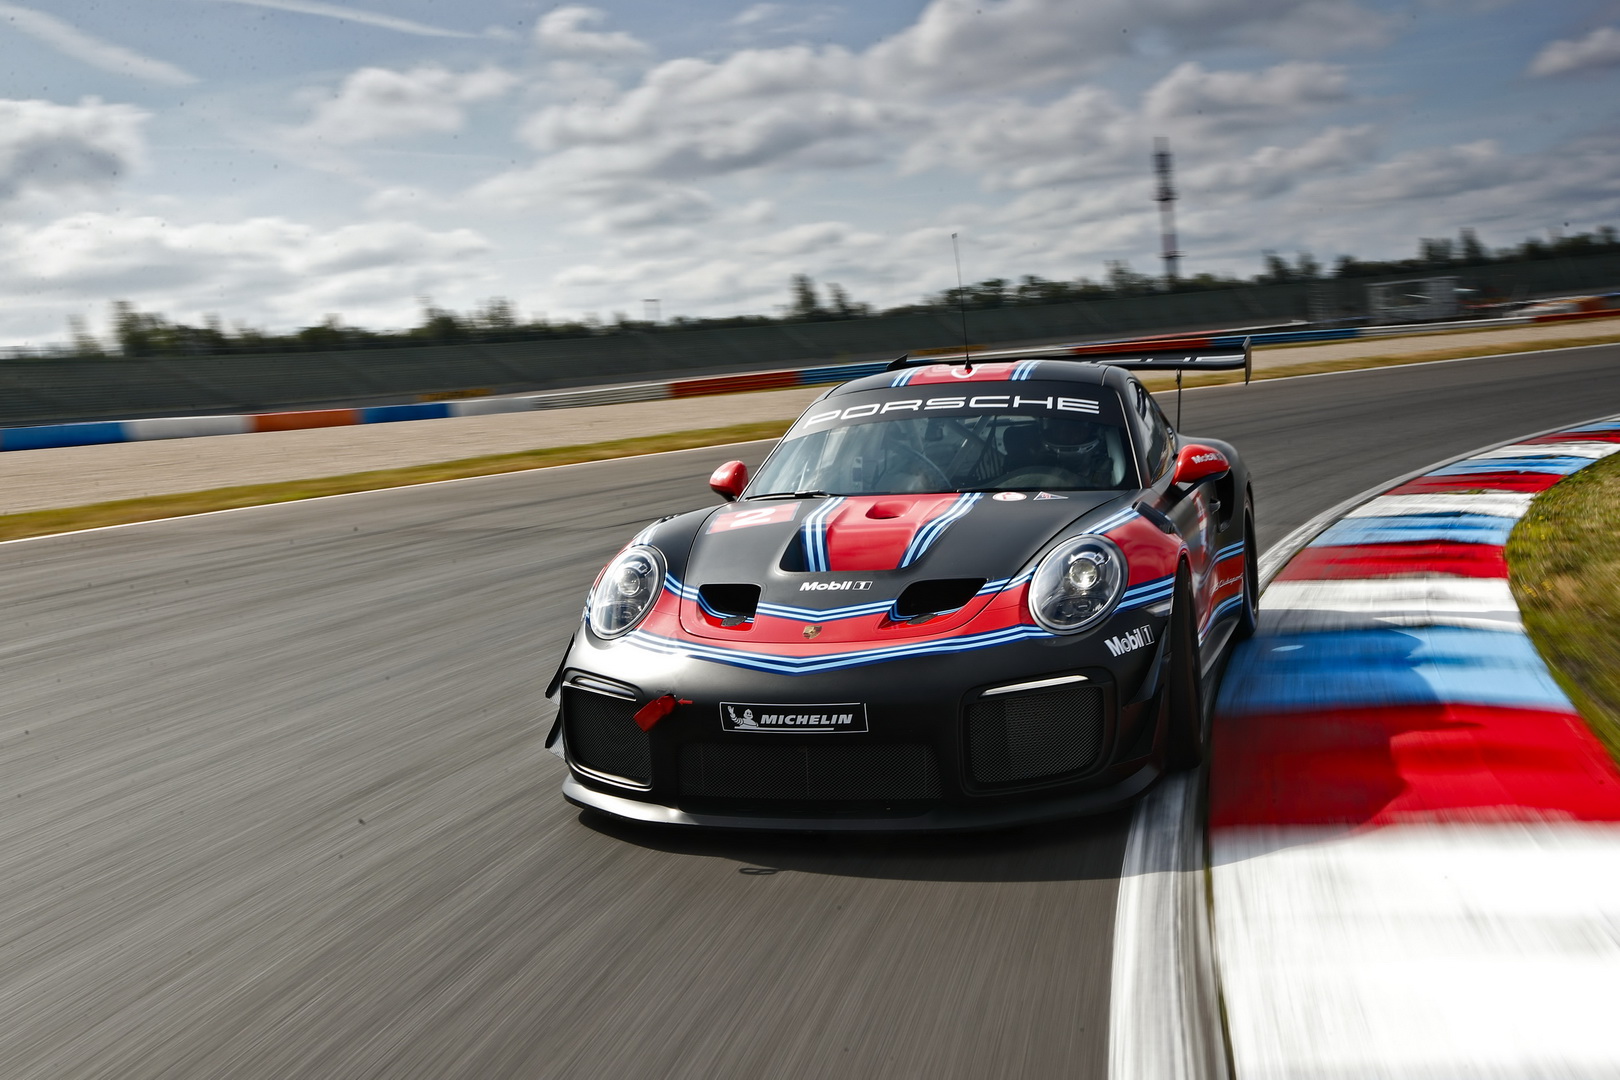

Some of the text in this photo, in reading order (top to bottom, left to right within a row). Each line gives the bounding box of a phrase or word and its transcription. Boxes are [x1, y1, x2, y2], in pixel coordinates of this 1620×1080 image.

[803, 395, 1100, 429] PORSCHE
[1191, 453, 1217, 464] Mobil
[729, 508, 777, 528] 2
[800, 581, 853, 591] Mobil
[1104, 628, 1145, 657] Mobil
[760, 713, 853, 725] MICHELIN
